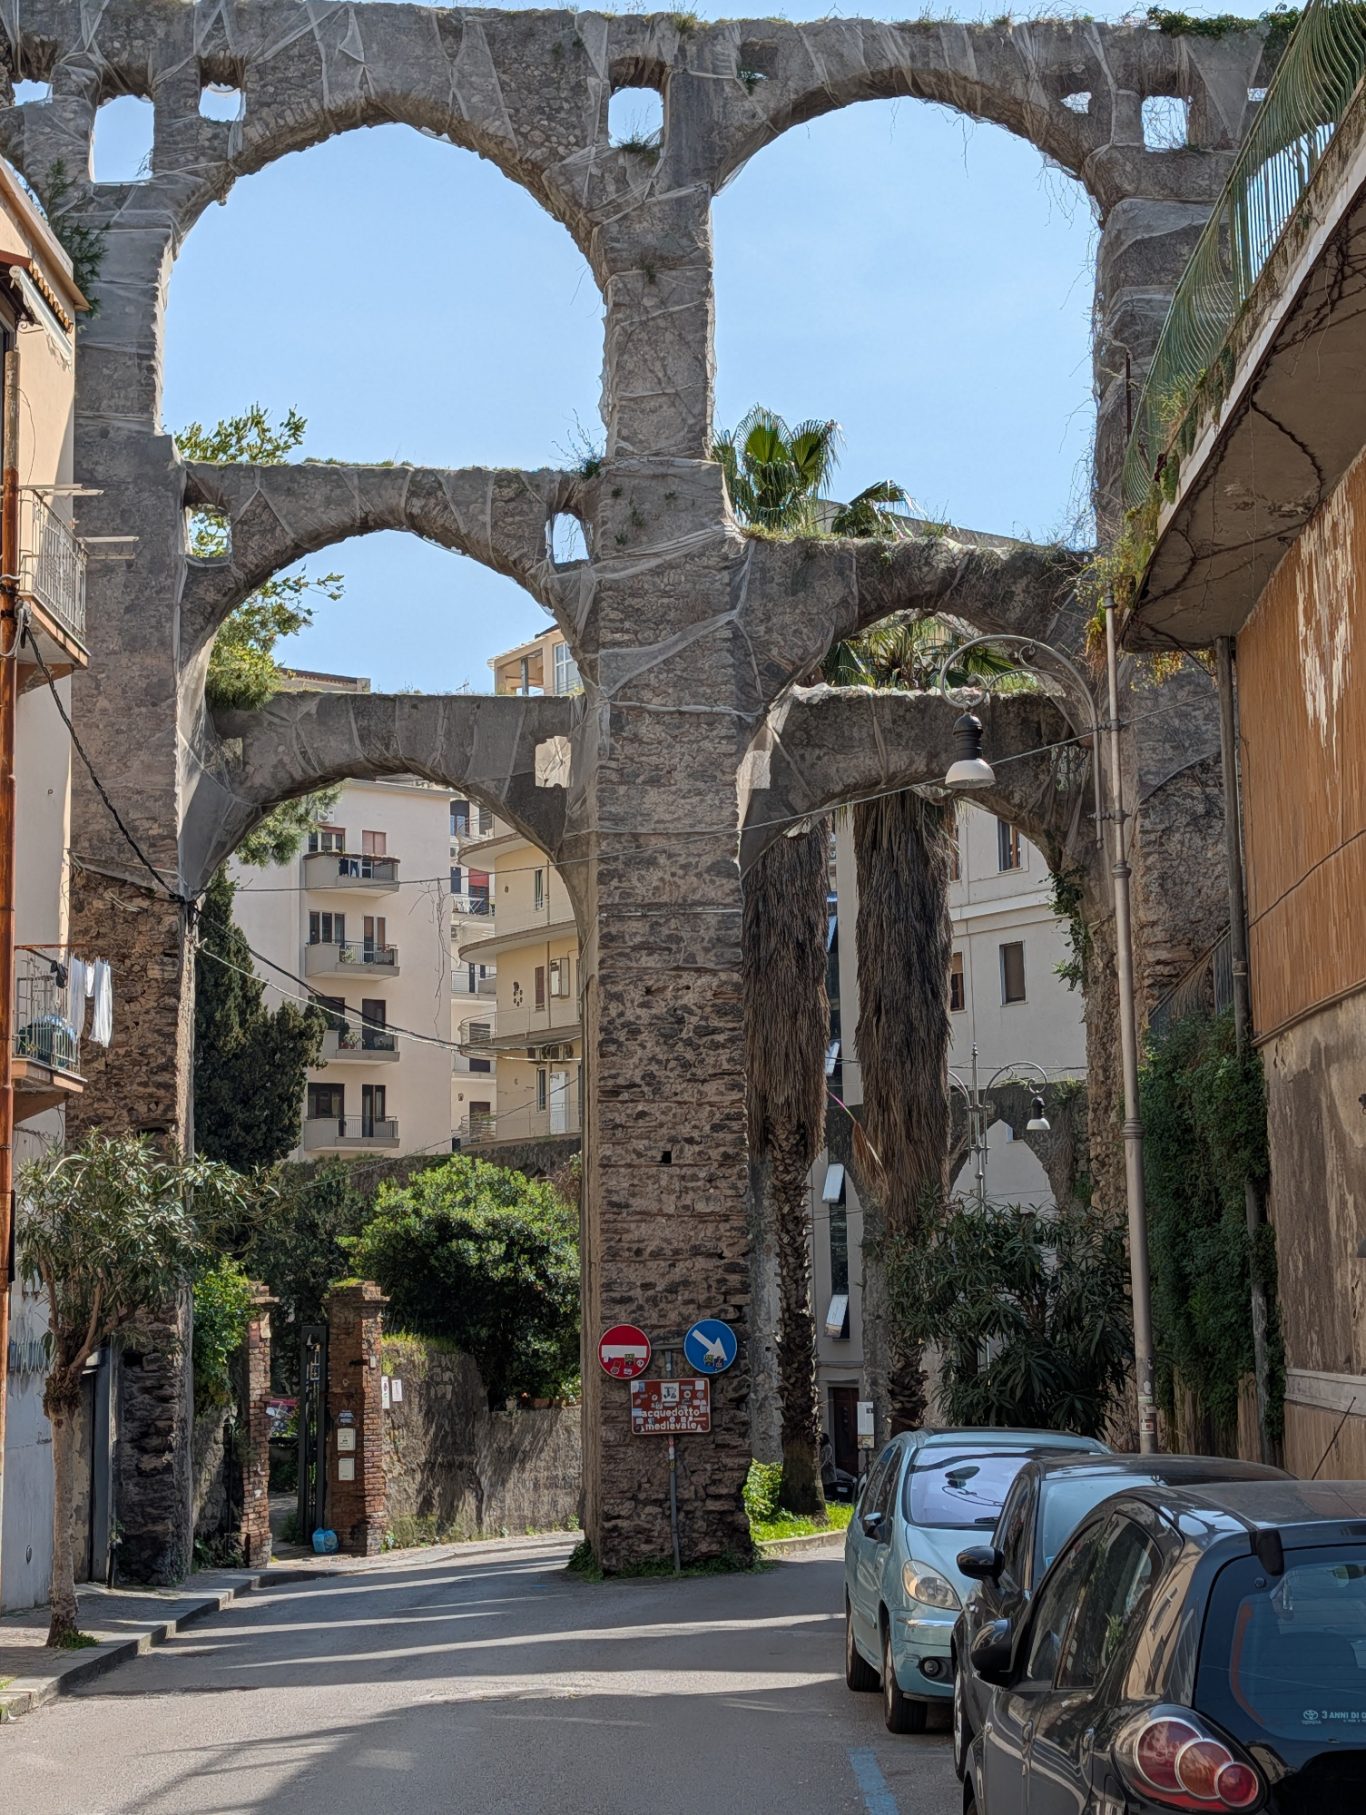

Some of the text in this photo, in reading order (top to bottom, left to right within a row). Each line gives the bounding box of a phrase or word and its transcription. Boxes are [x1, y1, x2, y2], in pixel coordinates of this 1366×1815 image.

[641, 1407, 700, 1418] acquedotto
[645, 1420, 697, 1431] medievale
[1321, 1710, 1328, 1719] 3
[1329, 1711, 1349, 1719] ANNI
[1351, 1711, 1360, 1719] DI
